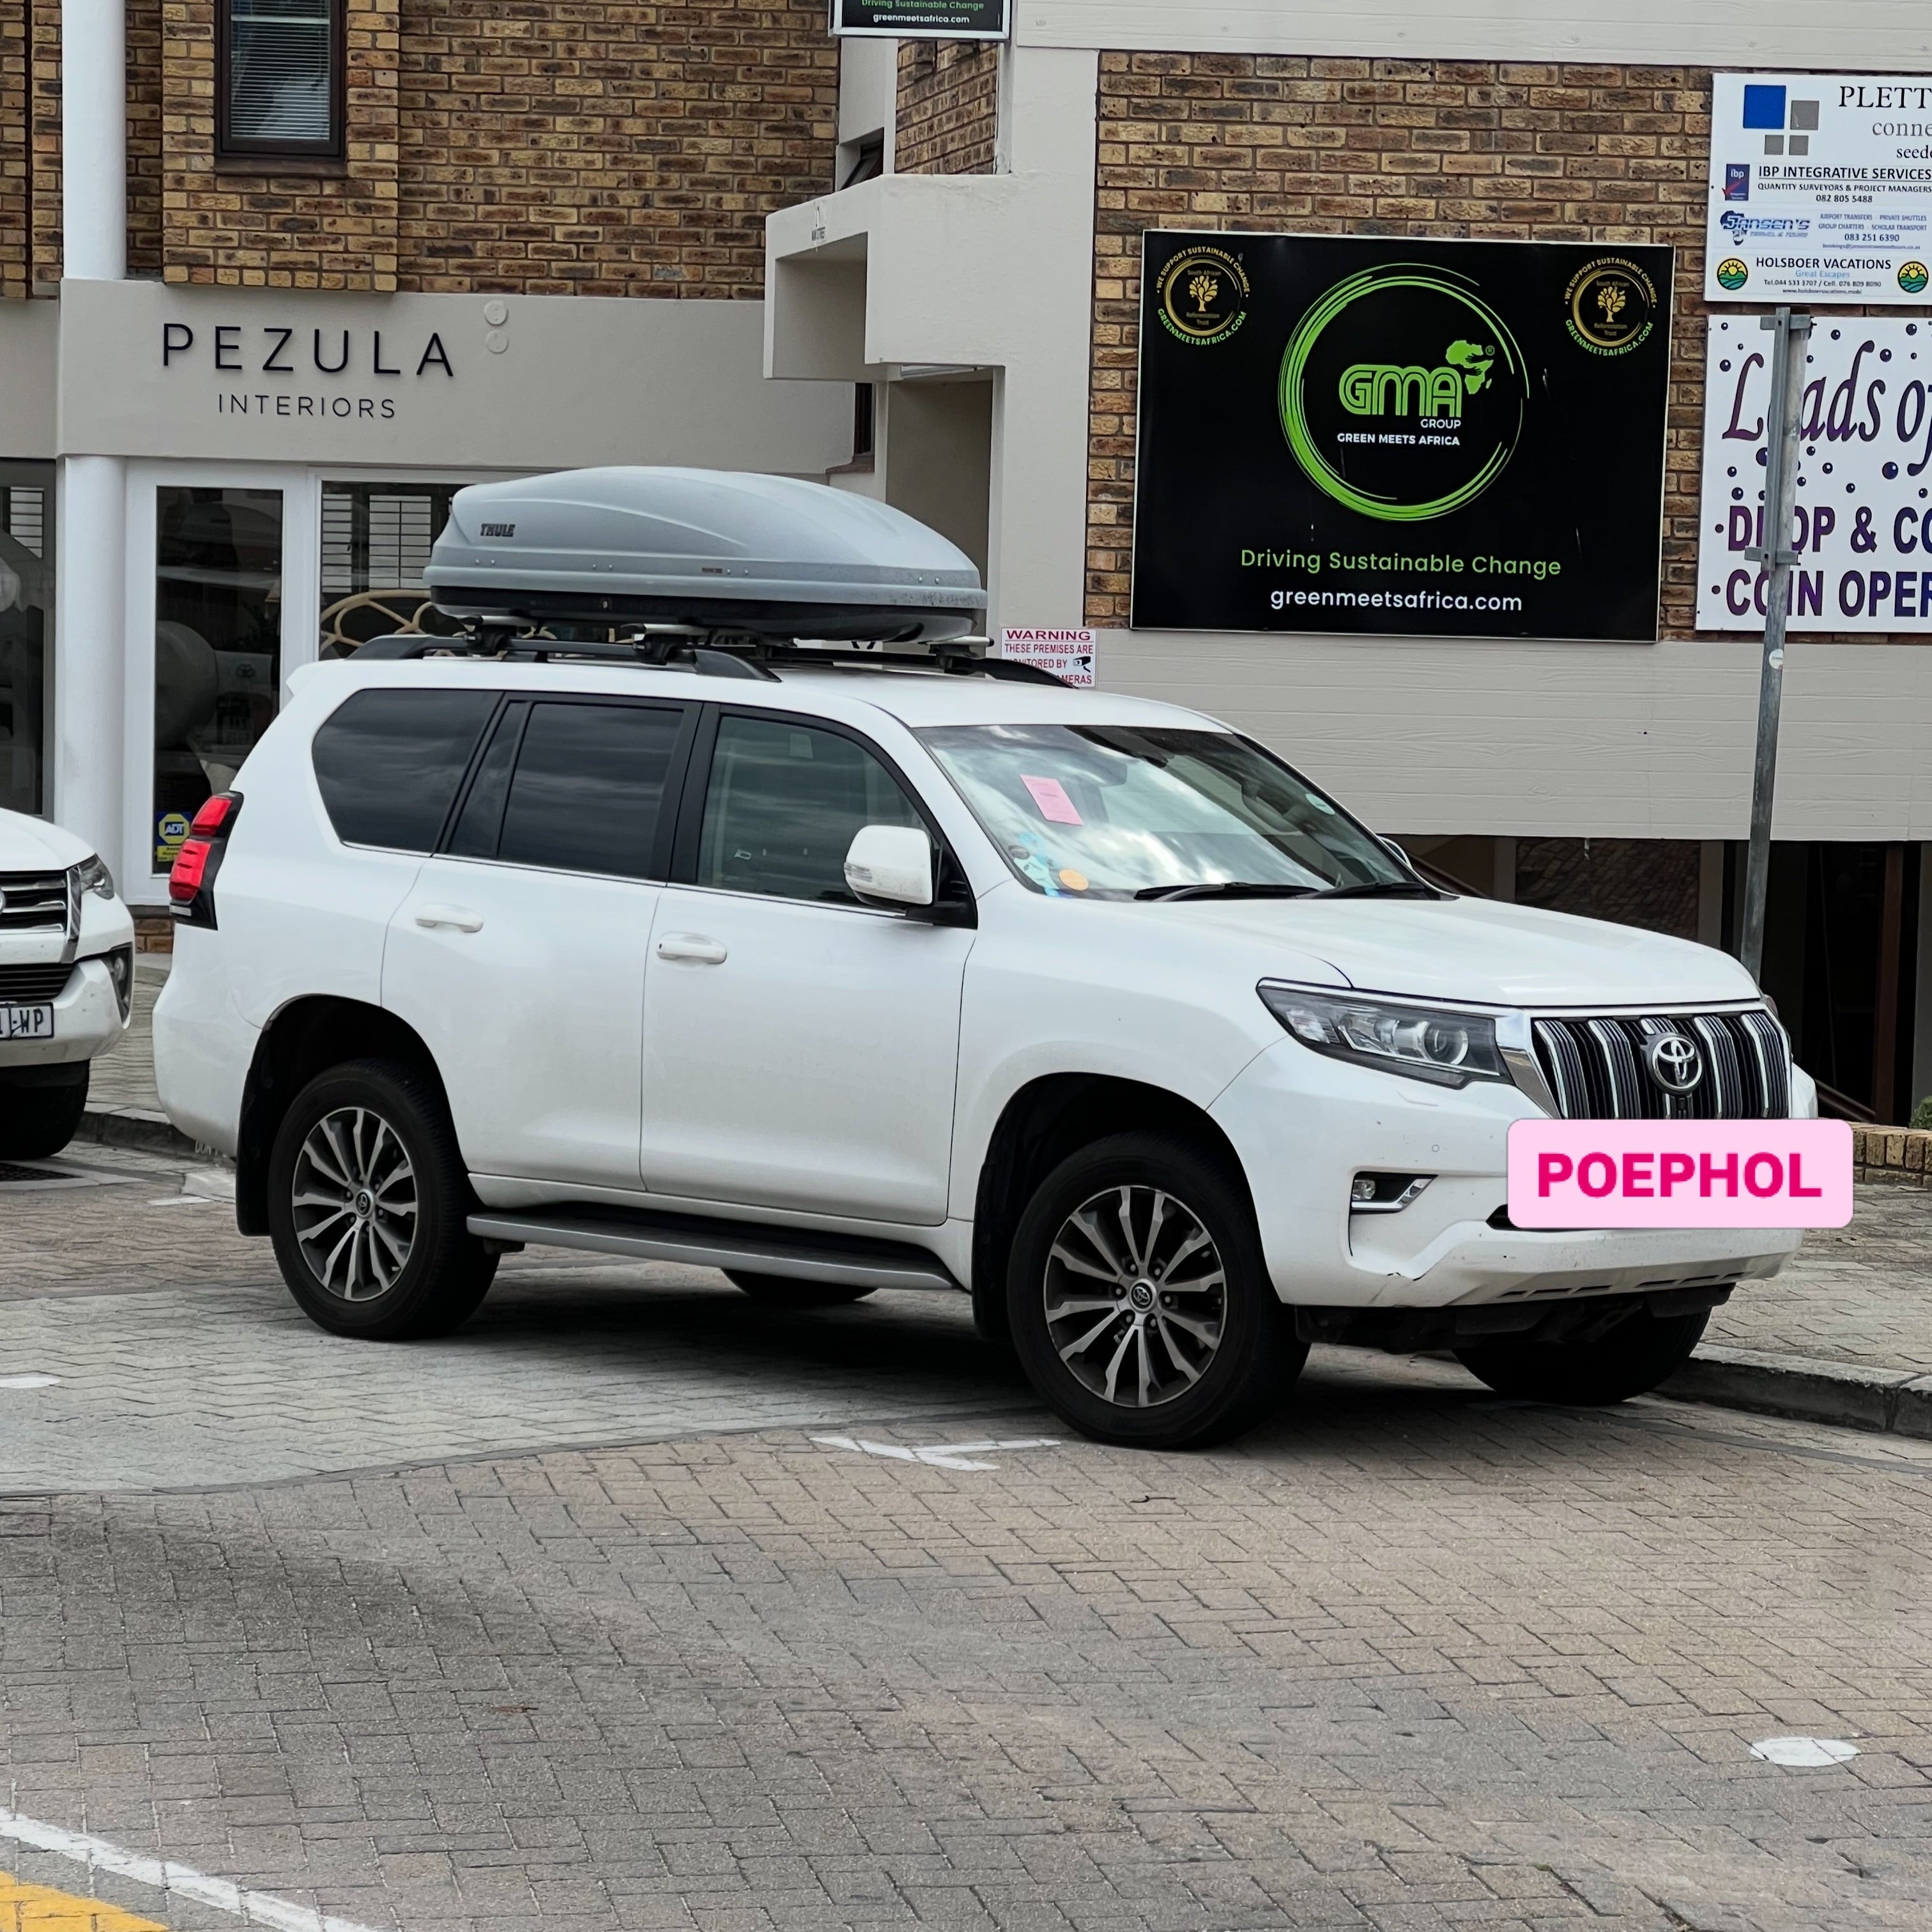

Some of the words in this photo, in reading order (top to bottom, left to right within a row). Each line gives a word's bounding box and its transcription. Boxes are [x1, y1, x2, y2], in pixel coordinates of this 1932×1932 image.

[862, 0, 893, 9] Driving
[895, 0, 947, 9] Sustainable
[949, 2, 984, 11] Change
[873, 14, 970, 23] greenmeetsafrica.com
[1838, 86, 1932, 109] PLETT
[1896, 144, 1932, 159] seed
[1759, 165, 1779, 177] IBP
[1784, 166, 1868, 179] INTEGRATIVE
[1872, 168, 1932, 180] SERVICES
[1799, 183, 1844, 192] SURVEYORS
[1852, 195, 1873, 203] 5488
[1156, 274, 1164, 289] WE
[1161, 250, 1186, 276] SUPPORT
[1188, 246, 1235, 264] SUSTAINABLE
[1233, 262, 1250, 293] CHANGE
[1756, 257, 1820, 268] HOLSBOER
[1824, 258, 1892, 270] VACATIONS
[1565, 287, 1573, 300] WE
[1569, 261, 1595, 288] SUPPORT
[1597, 257, 1643, 275] SUSTAINABLE
[1641, 273, 1657, 303] CHANGE
[1820, 270, 1850, 279] Escapes
[1158, 308, 1247, 346] GREENMEETSAFRICA.COM
[1566, 319, 1653, 356] GREENMEETSAFRICA.COM
[163, 323, 454, 378] PEZULA
[1339, 364, 1462, 418] GMA
[1722, 339, 1886, 442] Lads
[218, 393, 396, 419] INTERIORS
[1420, 418, 1462, 429] GROUP
[1337, 433, 1375, 443] GREEN
[1379, 434, 1416, 445] MEETS
[1418, 435, 1460, 446] AFRICA
[480, 523, 516, 537] THULE
[1850, 506, 1878, 554] &
[1241, 549, 1321, 574] Driving
[1330, 551, 1464, 573] Sustainable
[1472, 555, 1561, 580] Change
[1270, 590, 1522, 611] greenmeetsafrica.com
[1006, 630, 1091, 641] WARNING
[1004, 643, 1031, 653] THESE
[1033, 644, 1075, 654] PREMISES
[1077, 645, 1093, 654] ARE
[1057, 659, 1068, 668] BY
[1057, 675, 1092, 684] MERAS
[165, 823, 184, 834] ADT
